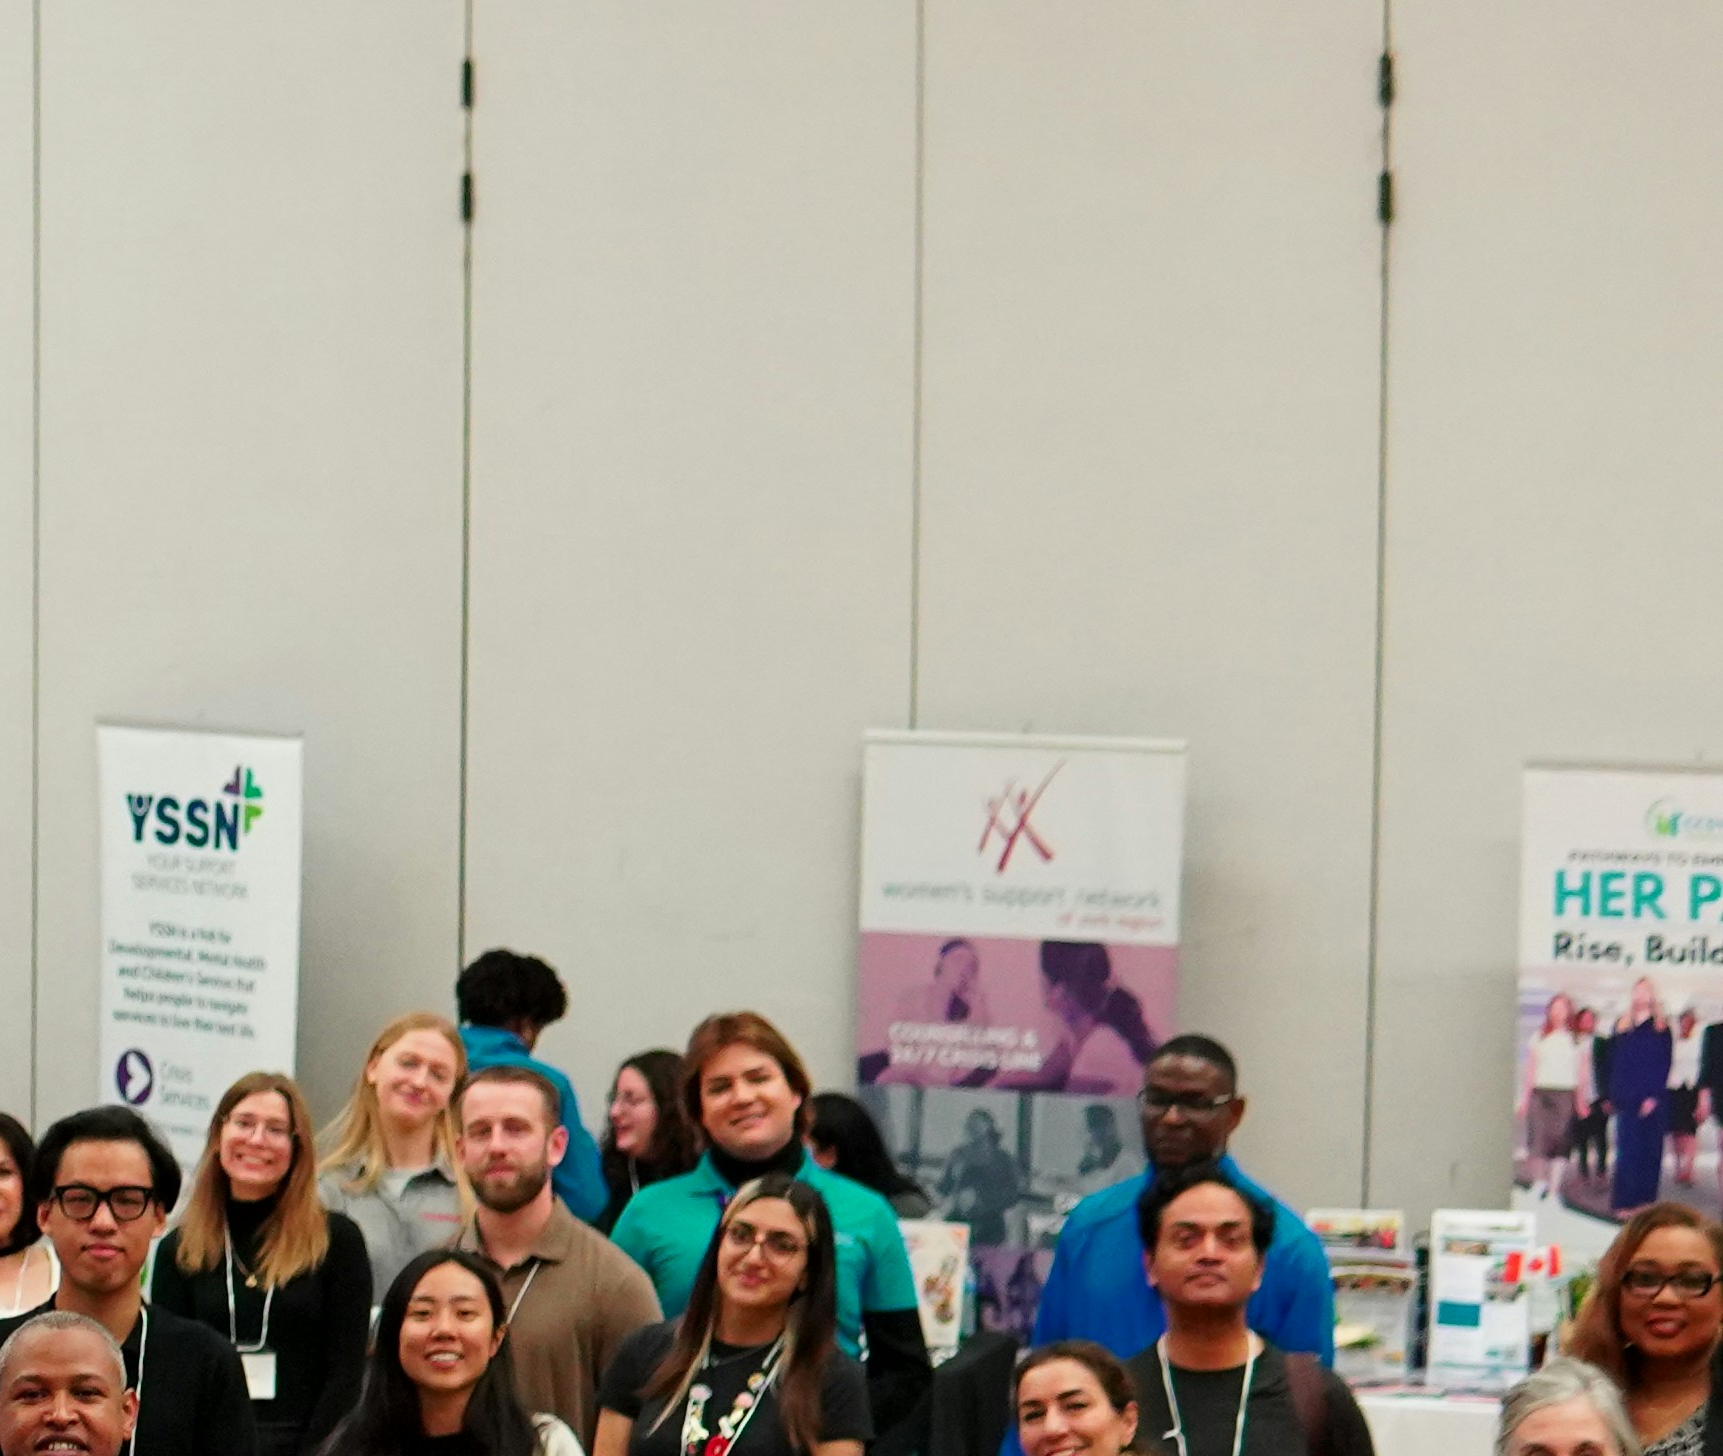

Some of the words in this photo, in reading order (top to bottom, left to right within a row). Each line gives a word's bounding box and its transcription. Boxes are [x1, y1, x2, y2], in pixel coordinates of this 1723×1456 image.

[125, 793, 239, 850] YSSN
[1554, 869, 1666, 919] HER
[1688, 872, 1723, 921] P
[1553, 930, 1635, 969] Rise,
